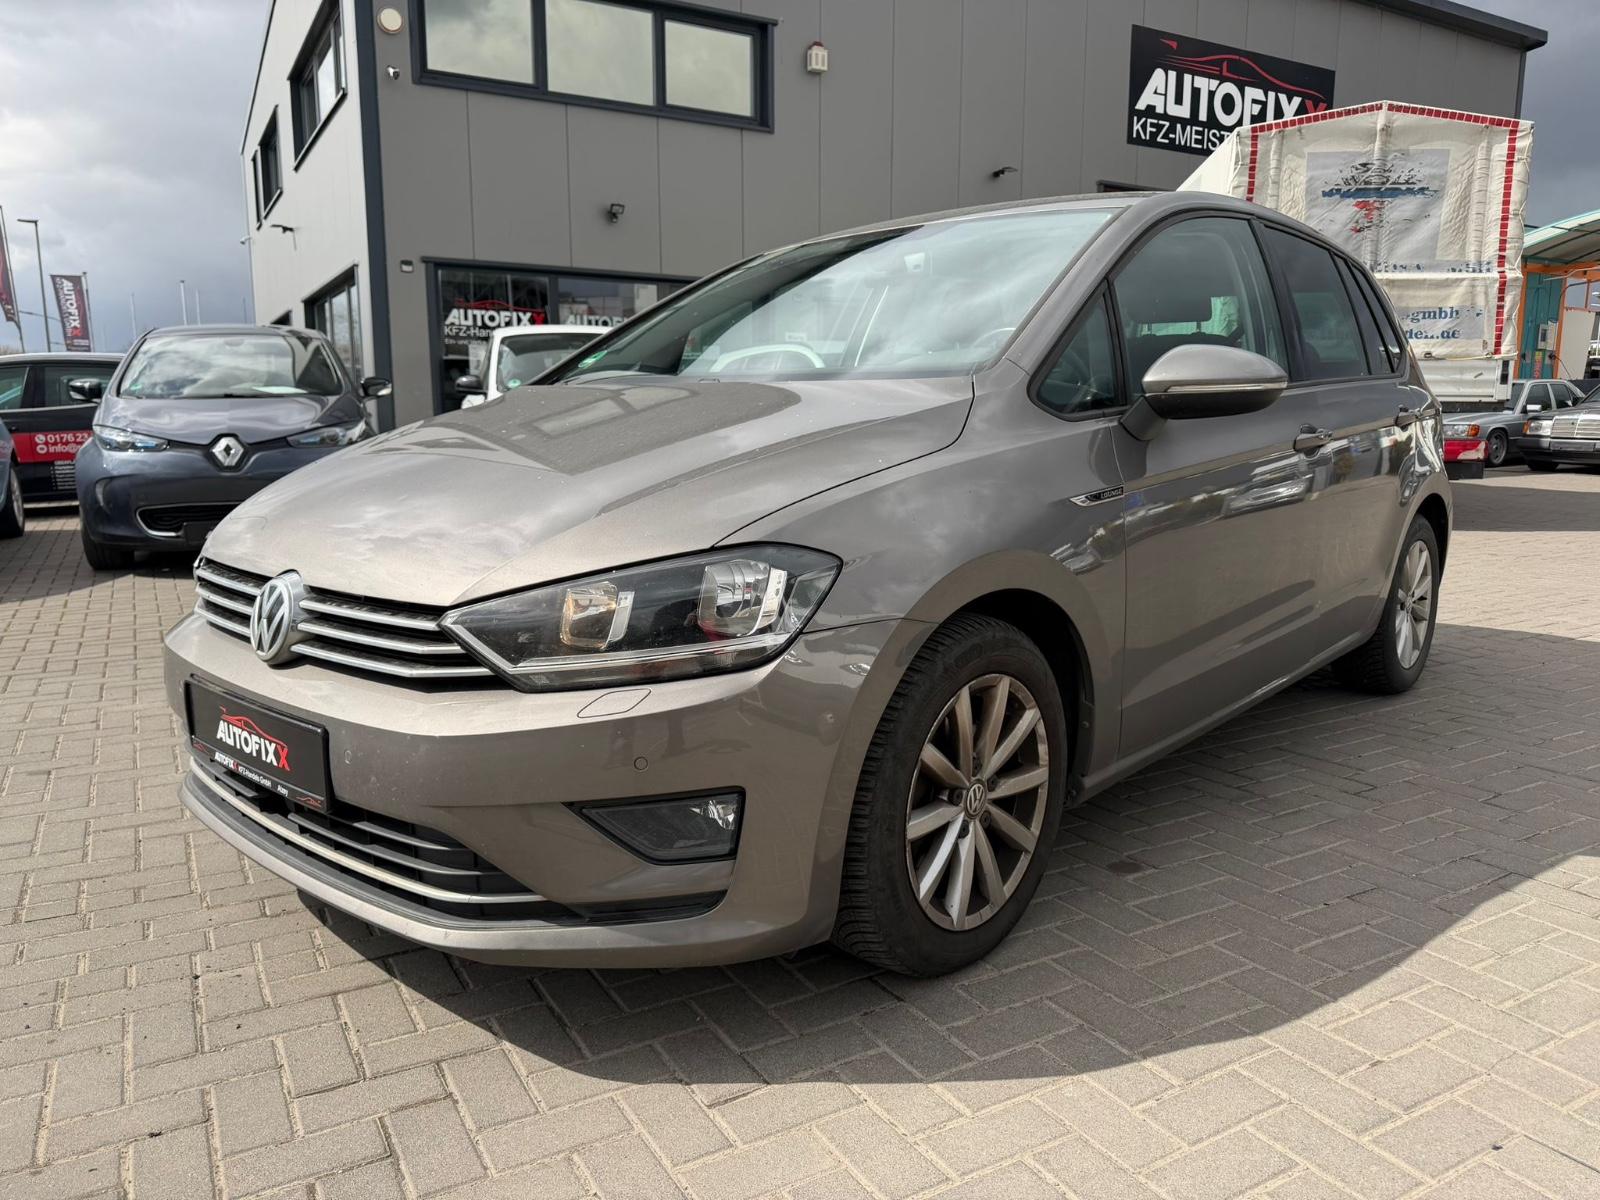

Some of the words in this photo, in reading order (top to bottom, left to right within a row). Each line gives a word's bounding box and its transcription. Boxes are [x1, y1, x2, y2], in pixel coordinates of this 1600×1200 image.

[565, 314, 627, 327] AUTOF
[47, 433, 75, 444] 0176
[216, 719, 290, 772] AUTOFIXX
